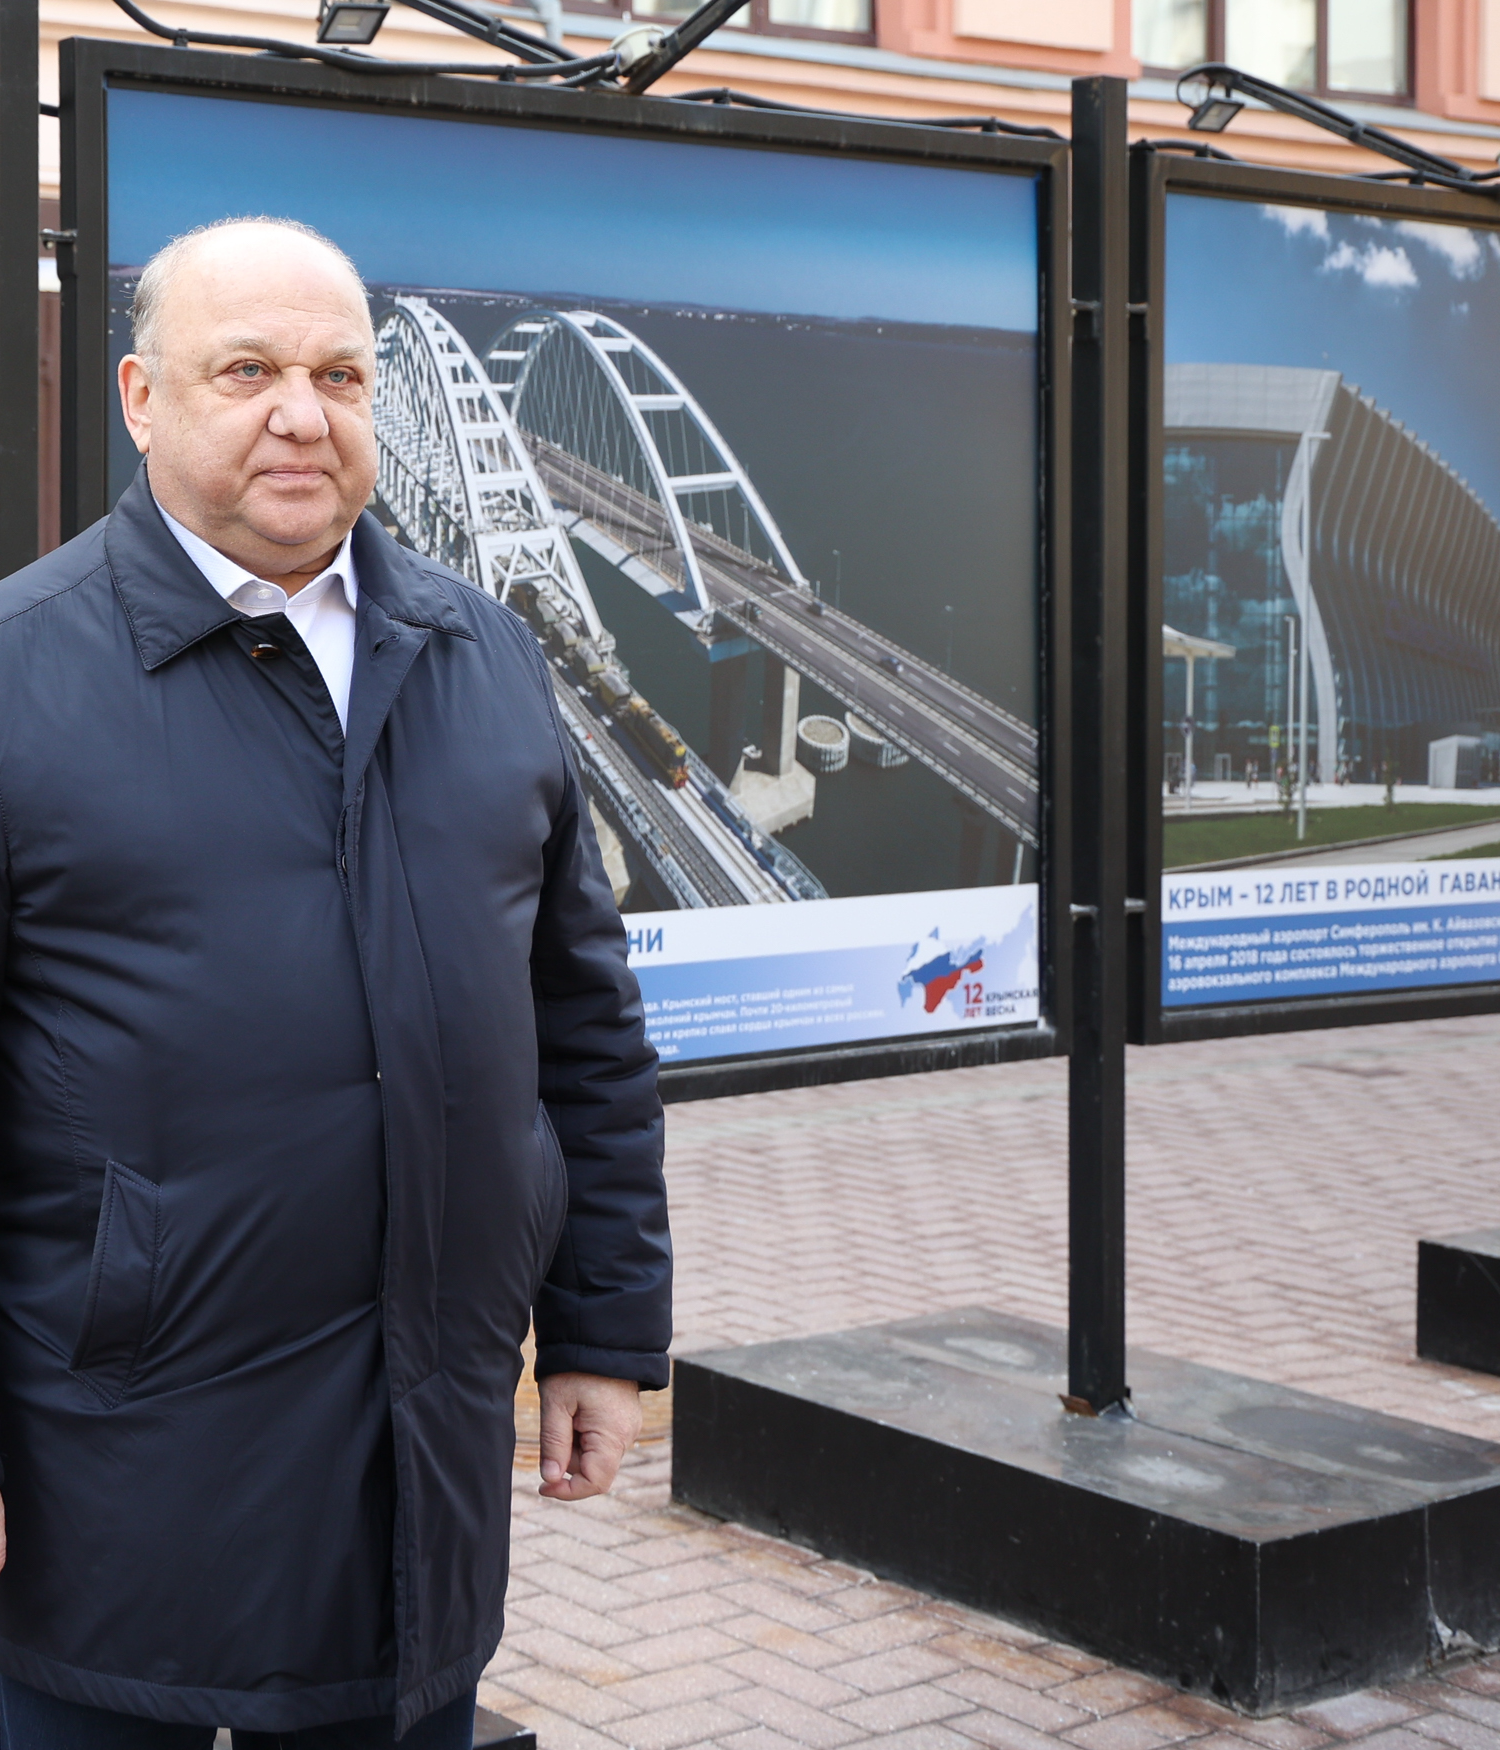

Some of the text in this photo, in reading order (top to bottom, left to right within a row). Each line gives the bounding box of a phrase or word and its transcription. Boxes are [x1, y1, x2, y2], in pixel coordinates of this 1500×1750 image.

[1169, 885, 1233, 910] КРЫМ
[1255, 883, 1274, 904] 12
[1280, 881, 1319, 904] ЛЕТ
[1326, 880, 1338, 901] В
[1345, 869, 1429, 901] РОДНОЙ
[1168, 928, 1271, 950] Международный
[1273, 927, 1329, 946] аэропорт
[1330, 922, 1411, 941] Симферополь
[1168, 935, 1498, 971] 16 апреля 2018 года состоялось торжественное открытие
[1168, 953, 1497, 993] аэровокзального комплекса Международного аэропорта
[662, 994, 712, 1011] Крымский
[964, 982, 983, 1005] 12
[740, 1004, 769, 1018] Почти
